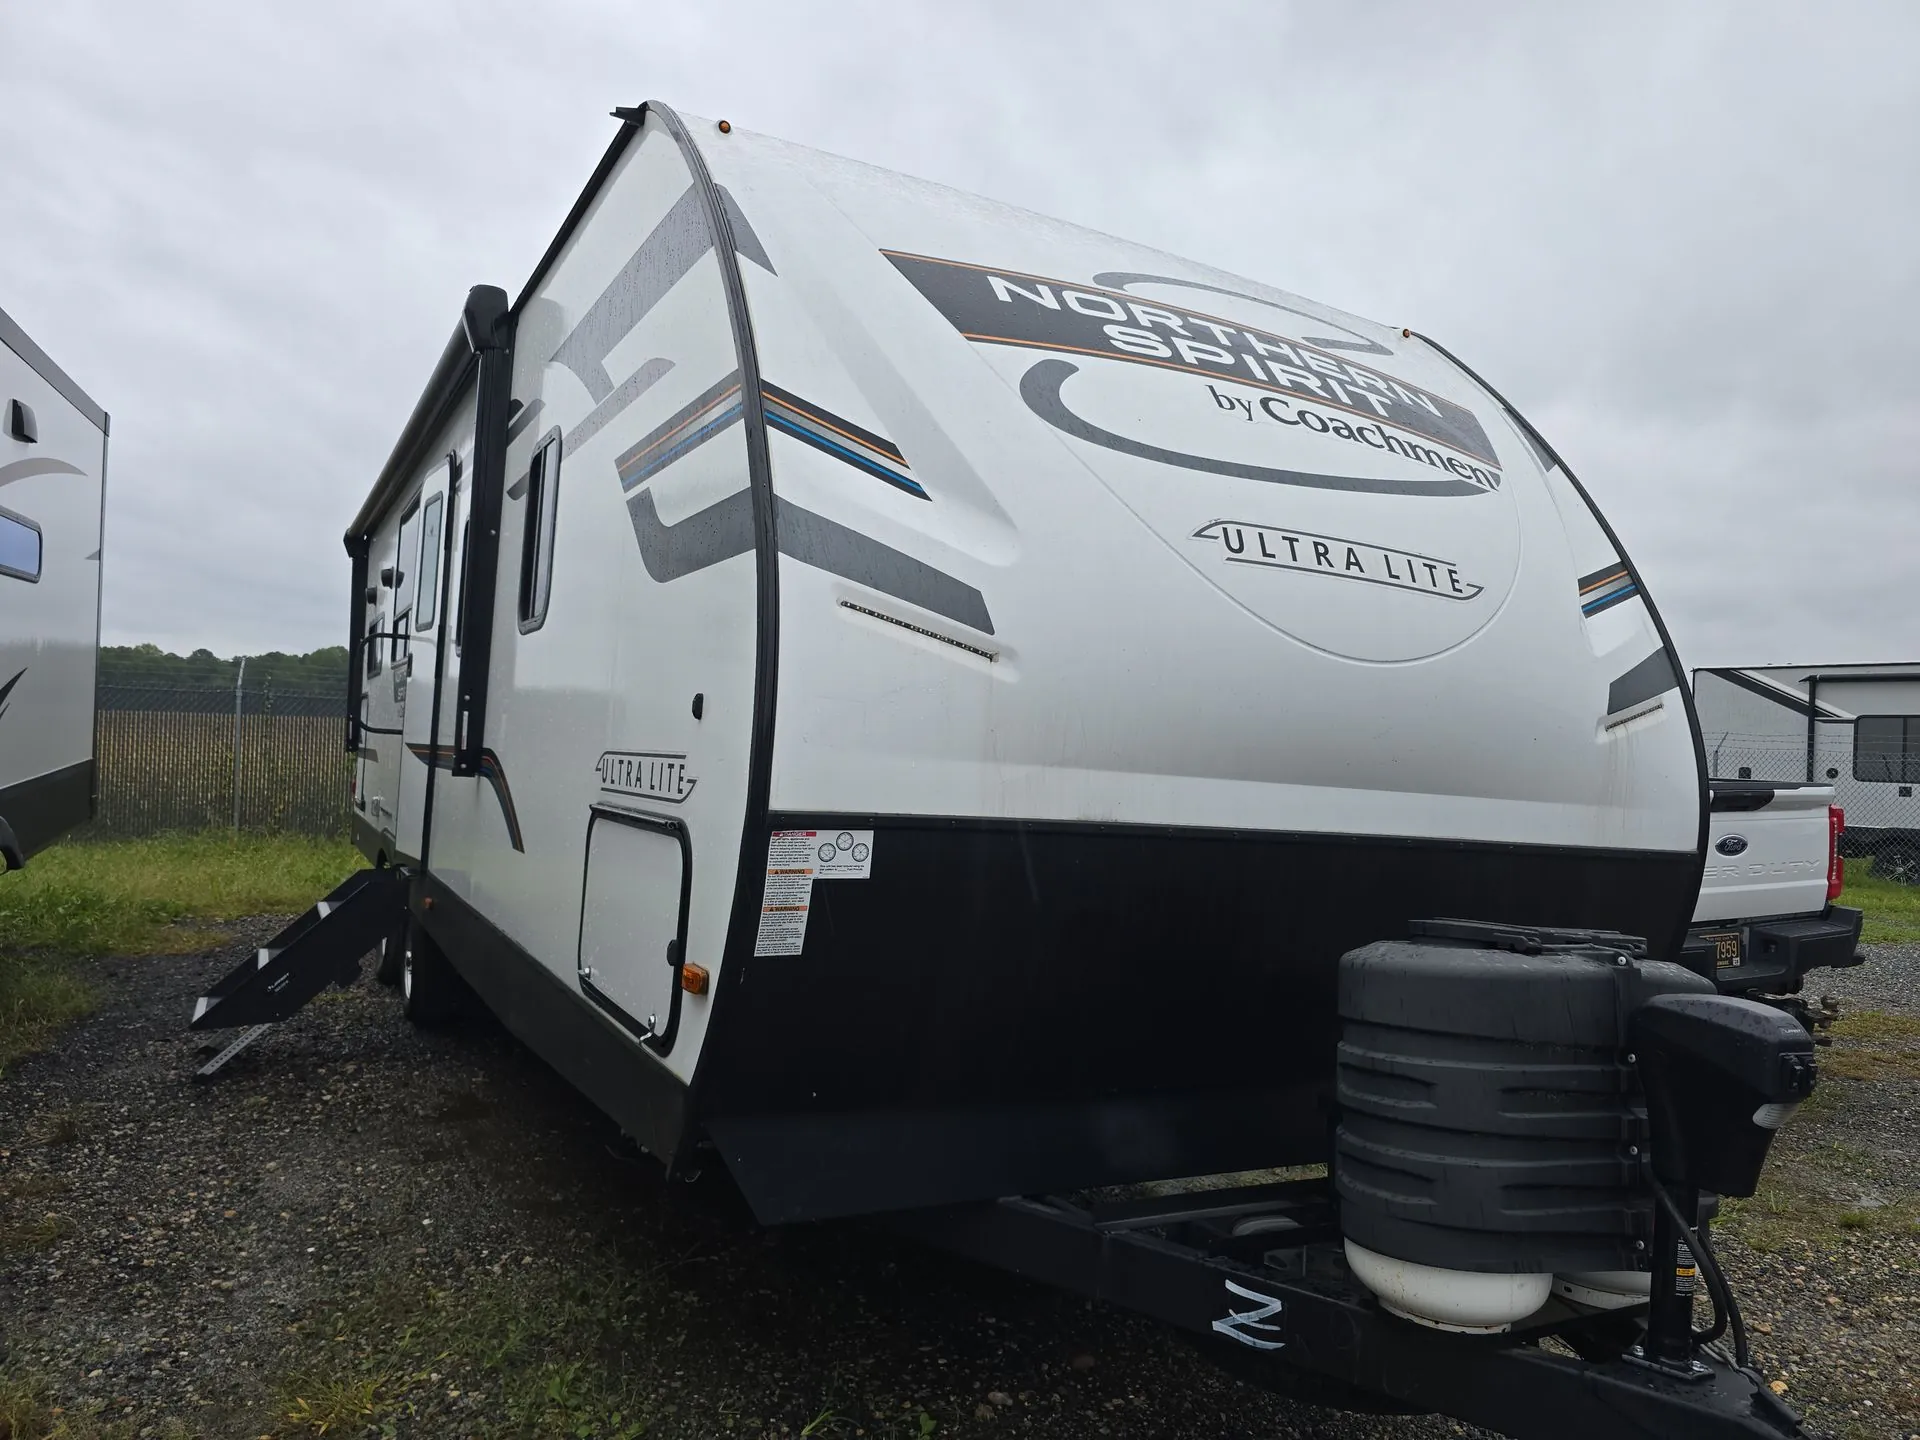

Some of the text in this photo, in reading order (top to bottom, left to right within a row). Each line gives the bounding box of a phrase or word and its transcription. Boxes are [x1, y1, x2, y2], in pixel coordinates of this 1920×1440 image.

[987, 275, 1443, 418] NORTHERN
[1103, 324, 1392, 417] SPIRIT
[1205, 384, 1499, 492] by Coachmen
[1222, 526, 1464, 594] ULTRA LITE
[601, 758, 686, 794] ULTRA LITE
[1715, 941, 1737, 959] 7959
